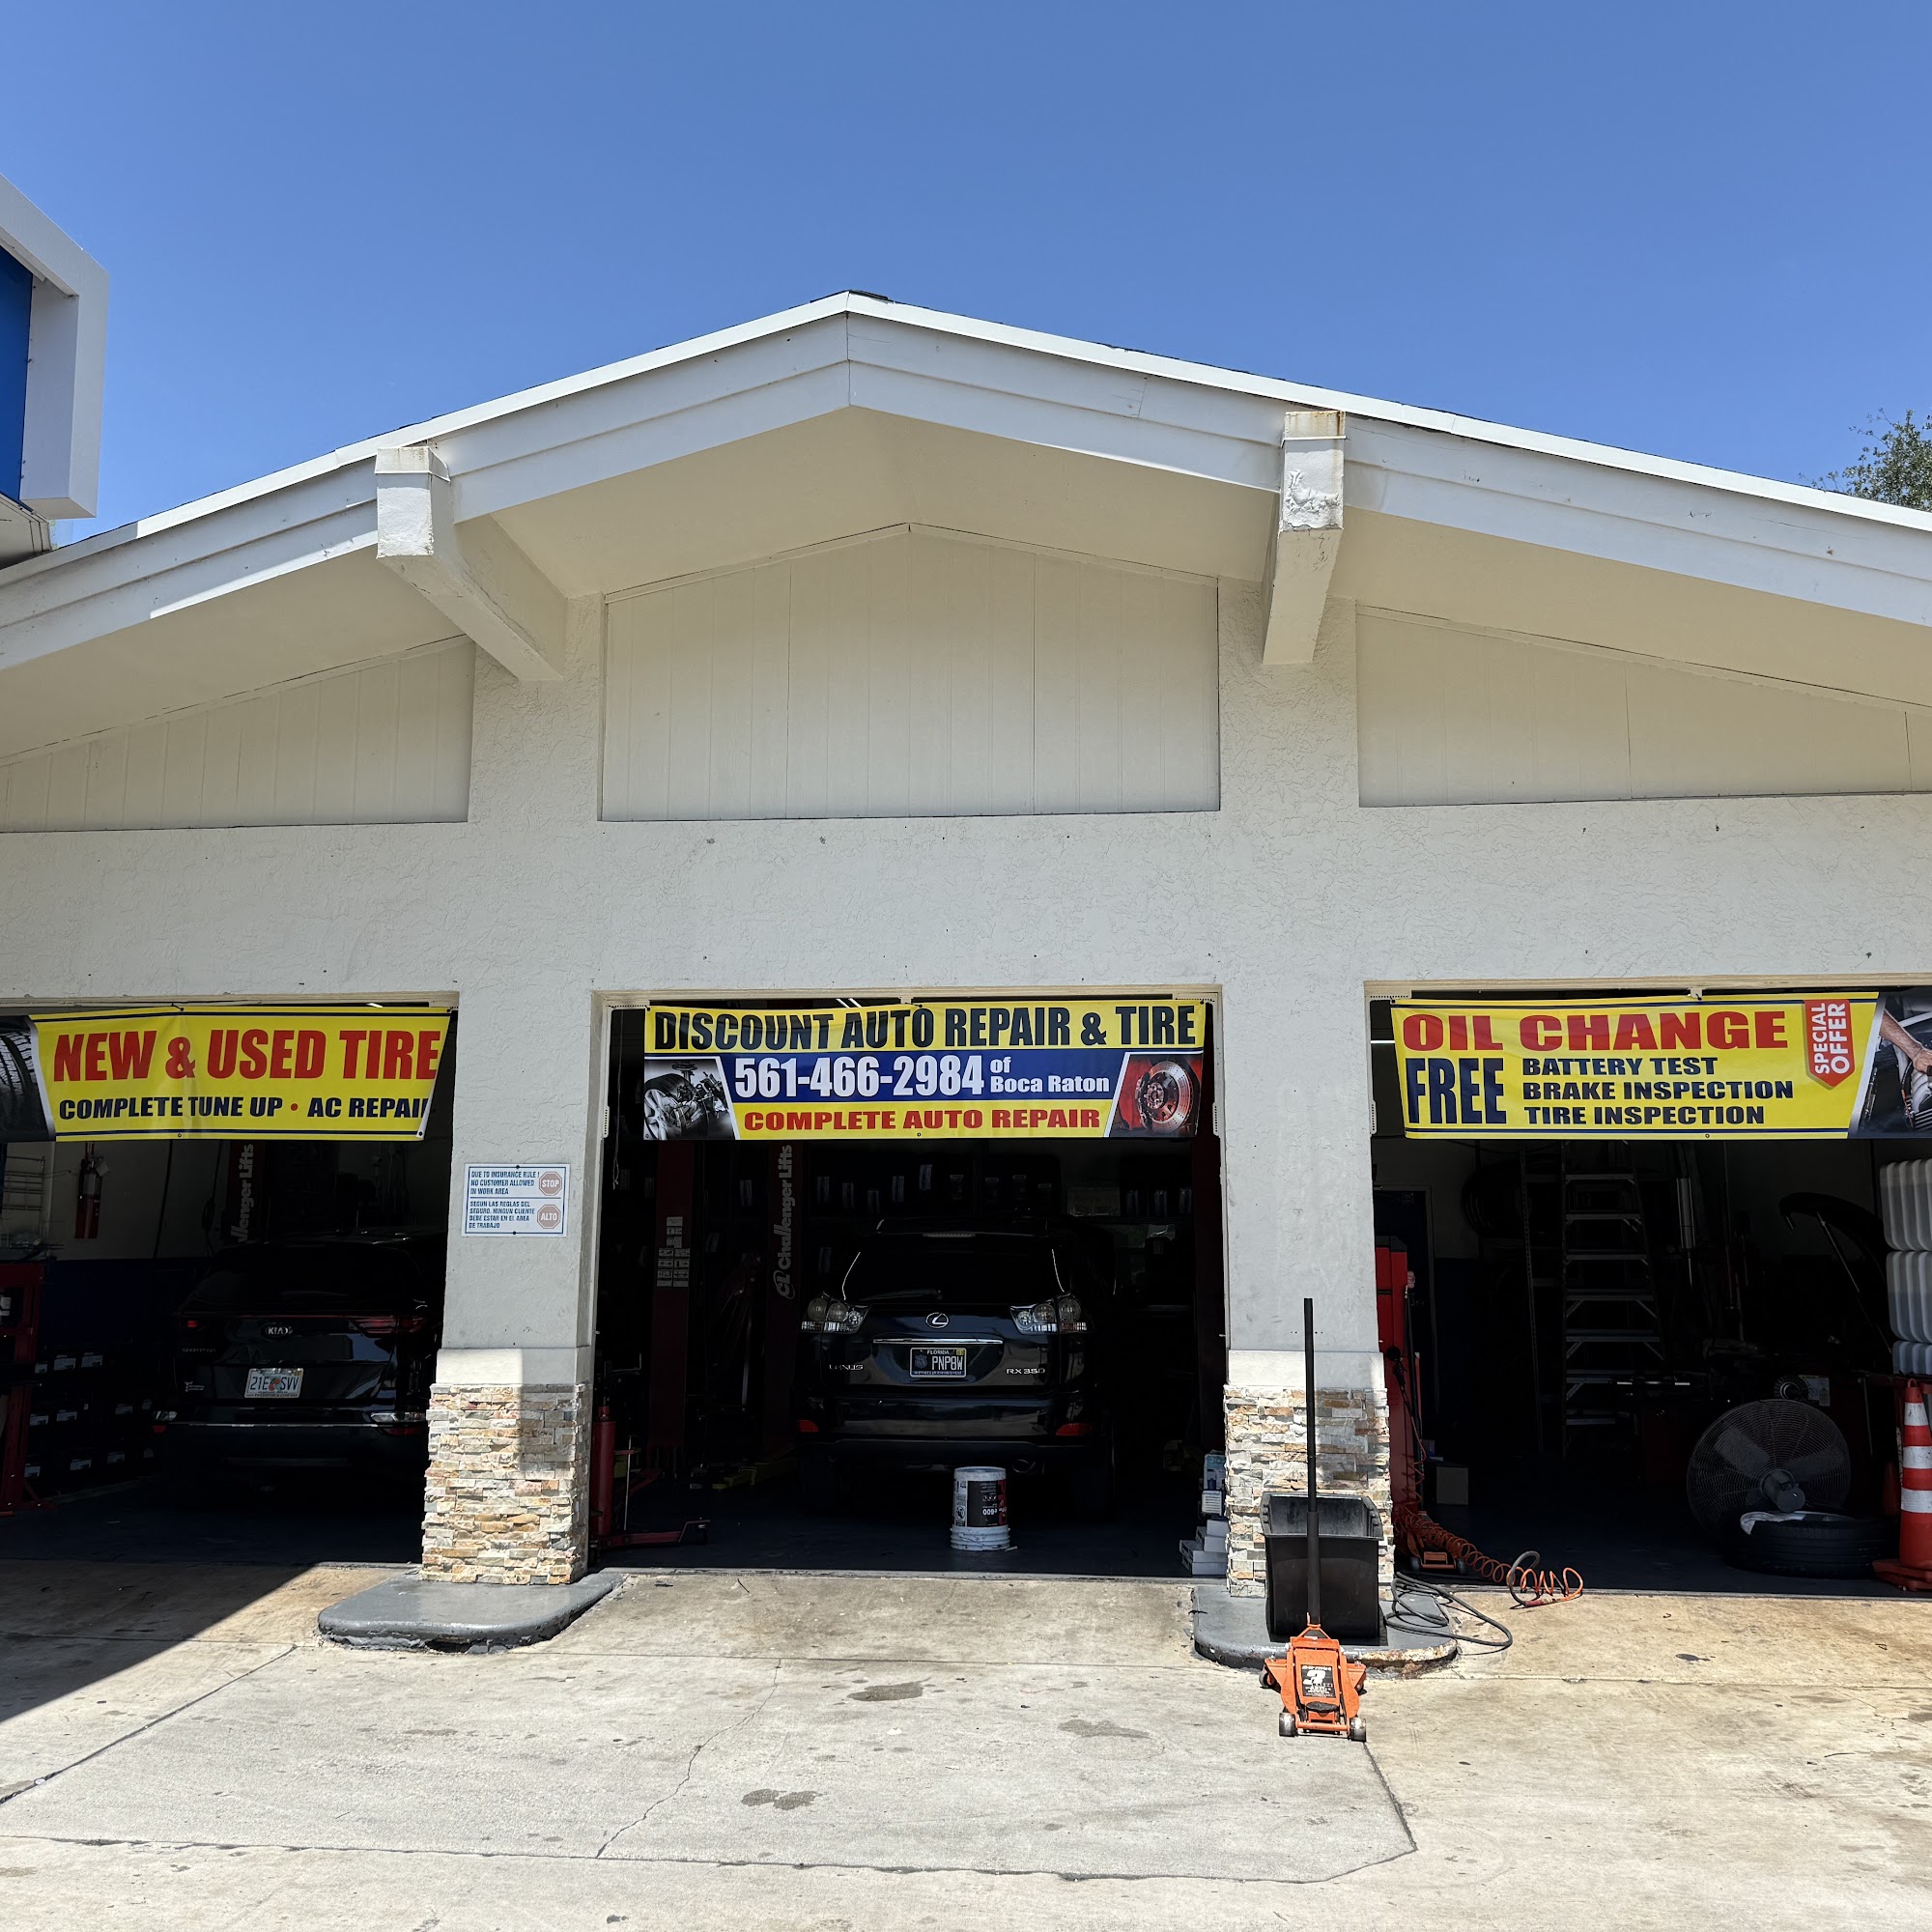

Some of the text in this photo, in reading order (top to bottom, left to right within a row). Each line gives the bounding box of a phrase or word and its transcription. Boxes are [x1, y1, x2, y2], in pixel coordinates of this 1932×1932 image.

[654, 1005, 1196, 1051] DISCOUNT AUTO REPAIR & TIRE
[1403, 1010, 1788, 1051] OIL CHANGE
[1814, 1002, 1831, 1074] SPECIAL
[1831, 1002, 1851, 1075] OFFER
[53, 1029, 441, 1082] NEW & USED TIRE
[990, 1056, 1011, 1074] of
[1522, 1057, 1718, 1076] BATTERY TEST
[734, 1054, 984, 1098] 561-466-2984
[990, 1075, 1110, 1094] Boca Raton
[1405, 1057, 1507, 1124] FREE
[1522, 1080, 1793, 1100] BRAKE INSPECTION
[59, 1096, 184, 1121] COMPLETE
[188, 1096, 243, 1118] TUNE
[249, 1096, 283, 1118] UP
[307, 1096, 341, 1119] AC
[743, 1108, 1100, 1131] COMPLETE AUTO REPAIR
[1523, 1105, 1765, 1125] TIRE INSPECTION
[778, 1144, 792, 1178] Lifts
[231, 1144, 254, 1242] llenger Lifts
[541, 1213, 557, 1221] ALTO
[774, 1179, 795, 1269] Challenger
[250, 1376, 270, 1390] 21E
